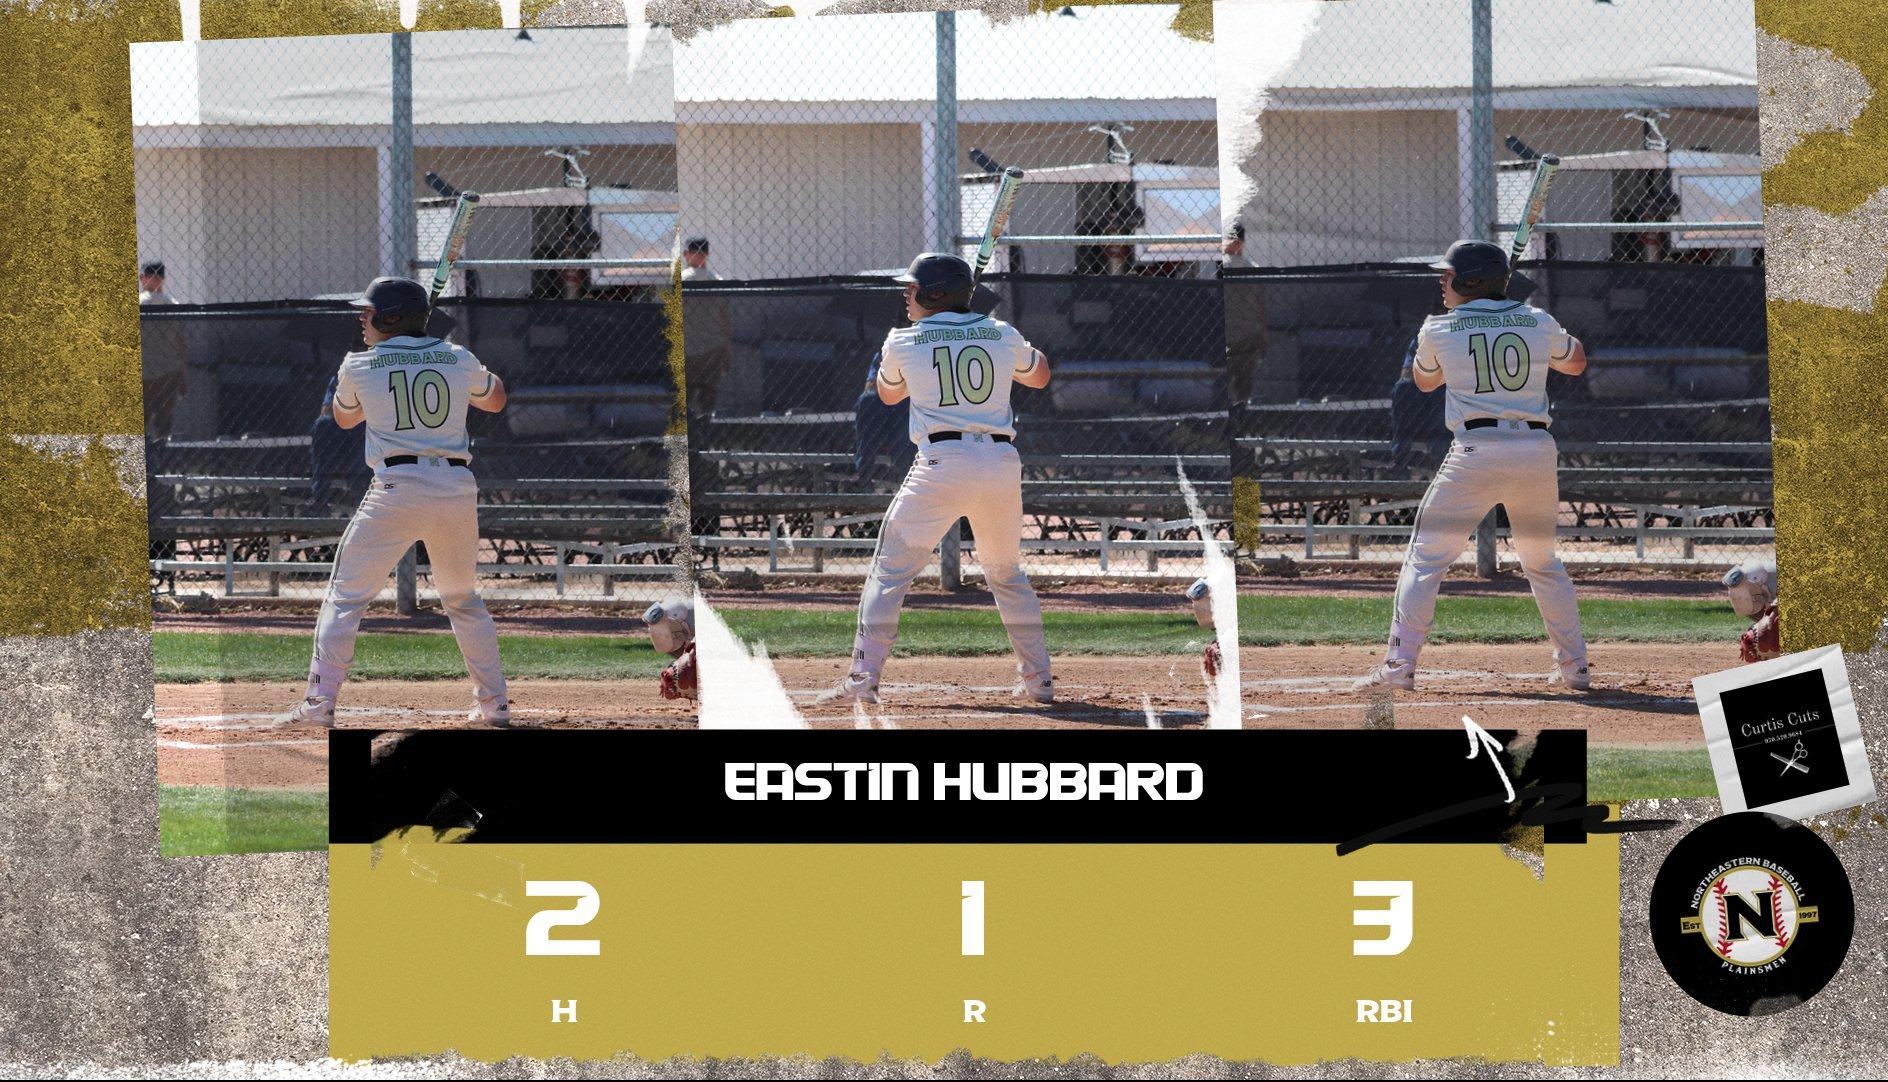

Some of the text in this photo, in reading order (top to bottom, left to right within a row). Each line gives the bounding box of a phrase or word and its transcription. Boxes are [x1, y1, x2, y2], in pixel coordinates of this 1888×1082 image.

[914, 327, 1002, 345] HUBBARD
[1450, 314, 1538, 332] HUBBARD
[370, 351, 458, 369] HUBBARD
[933, 345, 995, 407] 10
[1468, 332, 1531, 394] 10
[388, 369, 451, 431] 10
